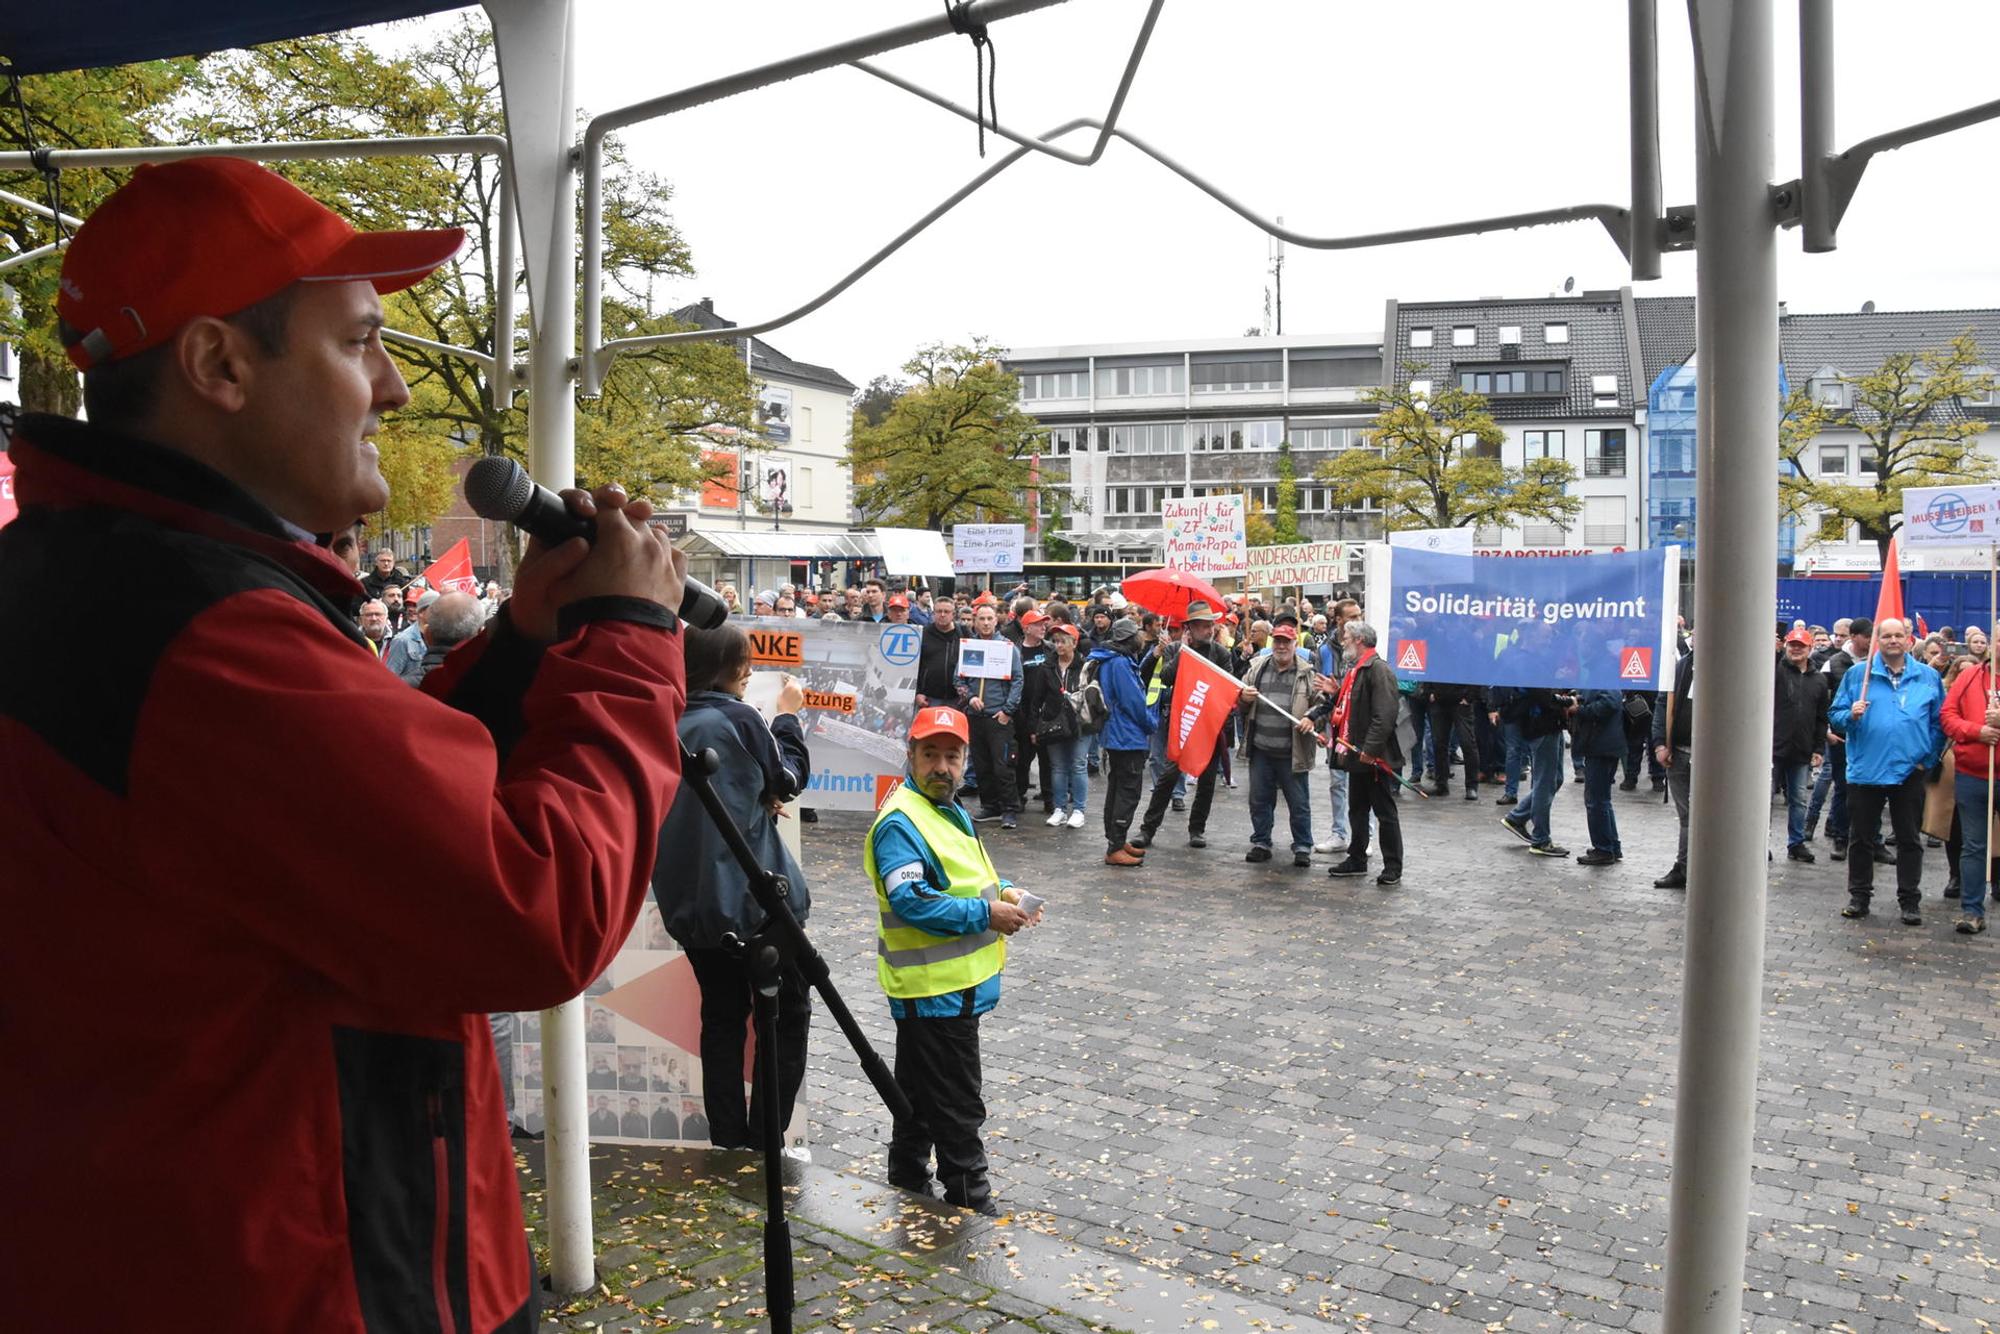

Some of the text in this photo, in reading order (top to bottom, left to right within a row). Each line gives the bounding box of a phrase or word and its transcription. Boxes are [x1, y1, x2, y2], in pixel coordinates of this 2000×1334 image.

[1165, 502, 1234, 521] Zukunft für
[1912, 511, 1941, 524] MUSS
[1183, 521, 1201, 533] ZF
[964, 539, 1016, 548] Eine Familie
[1169, 555, 1206, 572] Arbeit
[1247, 544, 1342, 567] KINDERGARTEN
[1247, 565, 1344, 587] DIE WALDWICHTEL
[1405, 591, 1646, 624] Solidarität gewinnt
[1188, 680, 1210, 707] DIE
